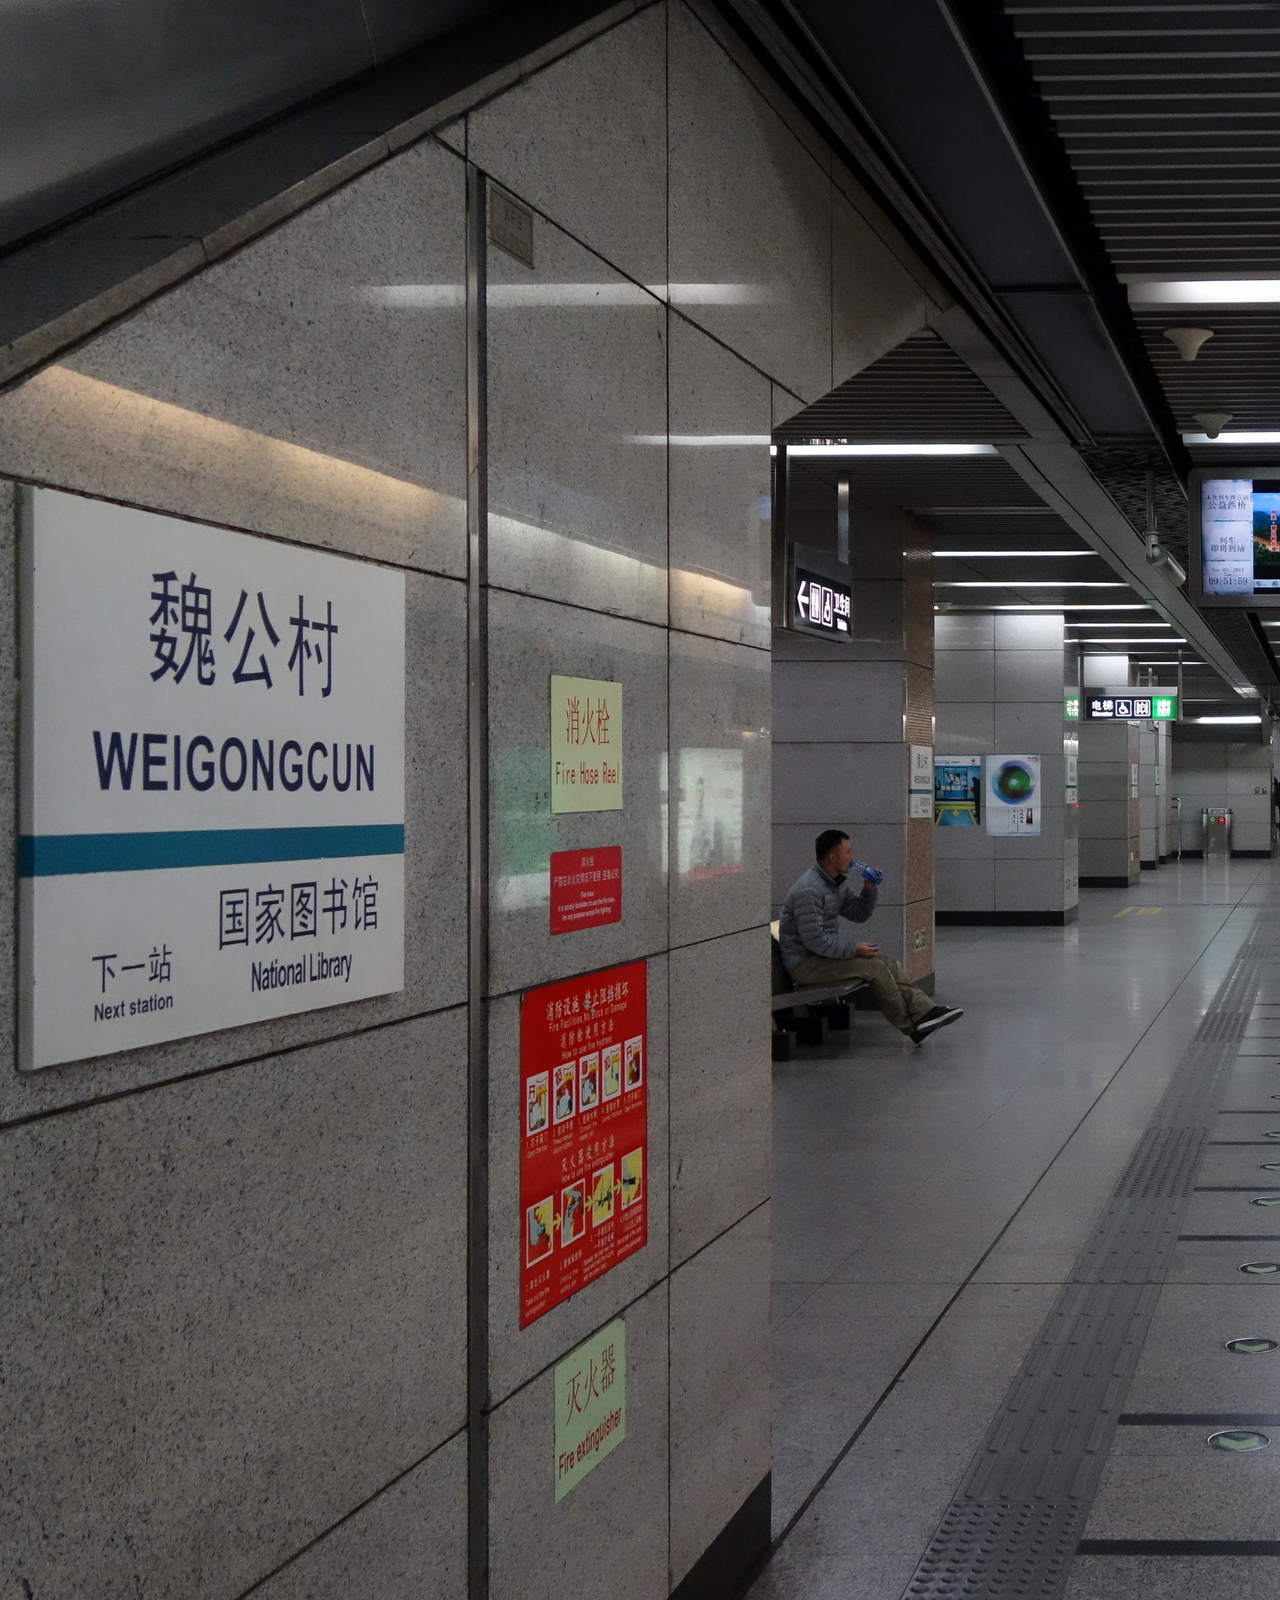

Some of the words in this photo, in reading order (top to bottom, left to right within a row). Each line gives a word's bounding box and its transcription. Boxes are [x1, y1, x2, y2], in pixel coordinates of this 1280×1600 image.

[1208, 500, 1247, 510] 公益西桥
[1210, 544, 1245, 553] 即将到站
[1208, 577, 1248, 585] 09:51:59
[150, 570, 339, 698] 魏公村
[566, 696, 610, 745] 消火栓
[1091, 699, 1114, 711] 电梯
[92, 730, 375, 792] WEIGONGCUN
[555, 761, 576, 785] Fire
[580, 761, 599, 785] Hose
[602, 761, 620, 785] Reel
[218, 875, 379, 950] 国家图书馆
[92, 944, 173, 993] 下一站
[251, 954, 306, 992] National
[310, 952, 352, 984] Library
[94, 1001, 126, 1022] Next
[129, 994, 173, 1017] station
[548, 1022, 559, 1032] Fire
[561, 1049, 571, 1060] How
[565, 1343, 616, 1427] 灭火器
[558, 1449, 574, 1480] Fire
[576, 1406, 622, 1462] extinguisher
